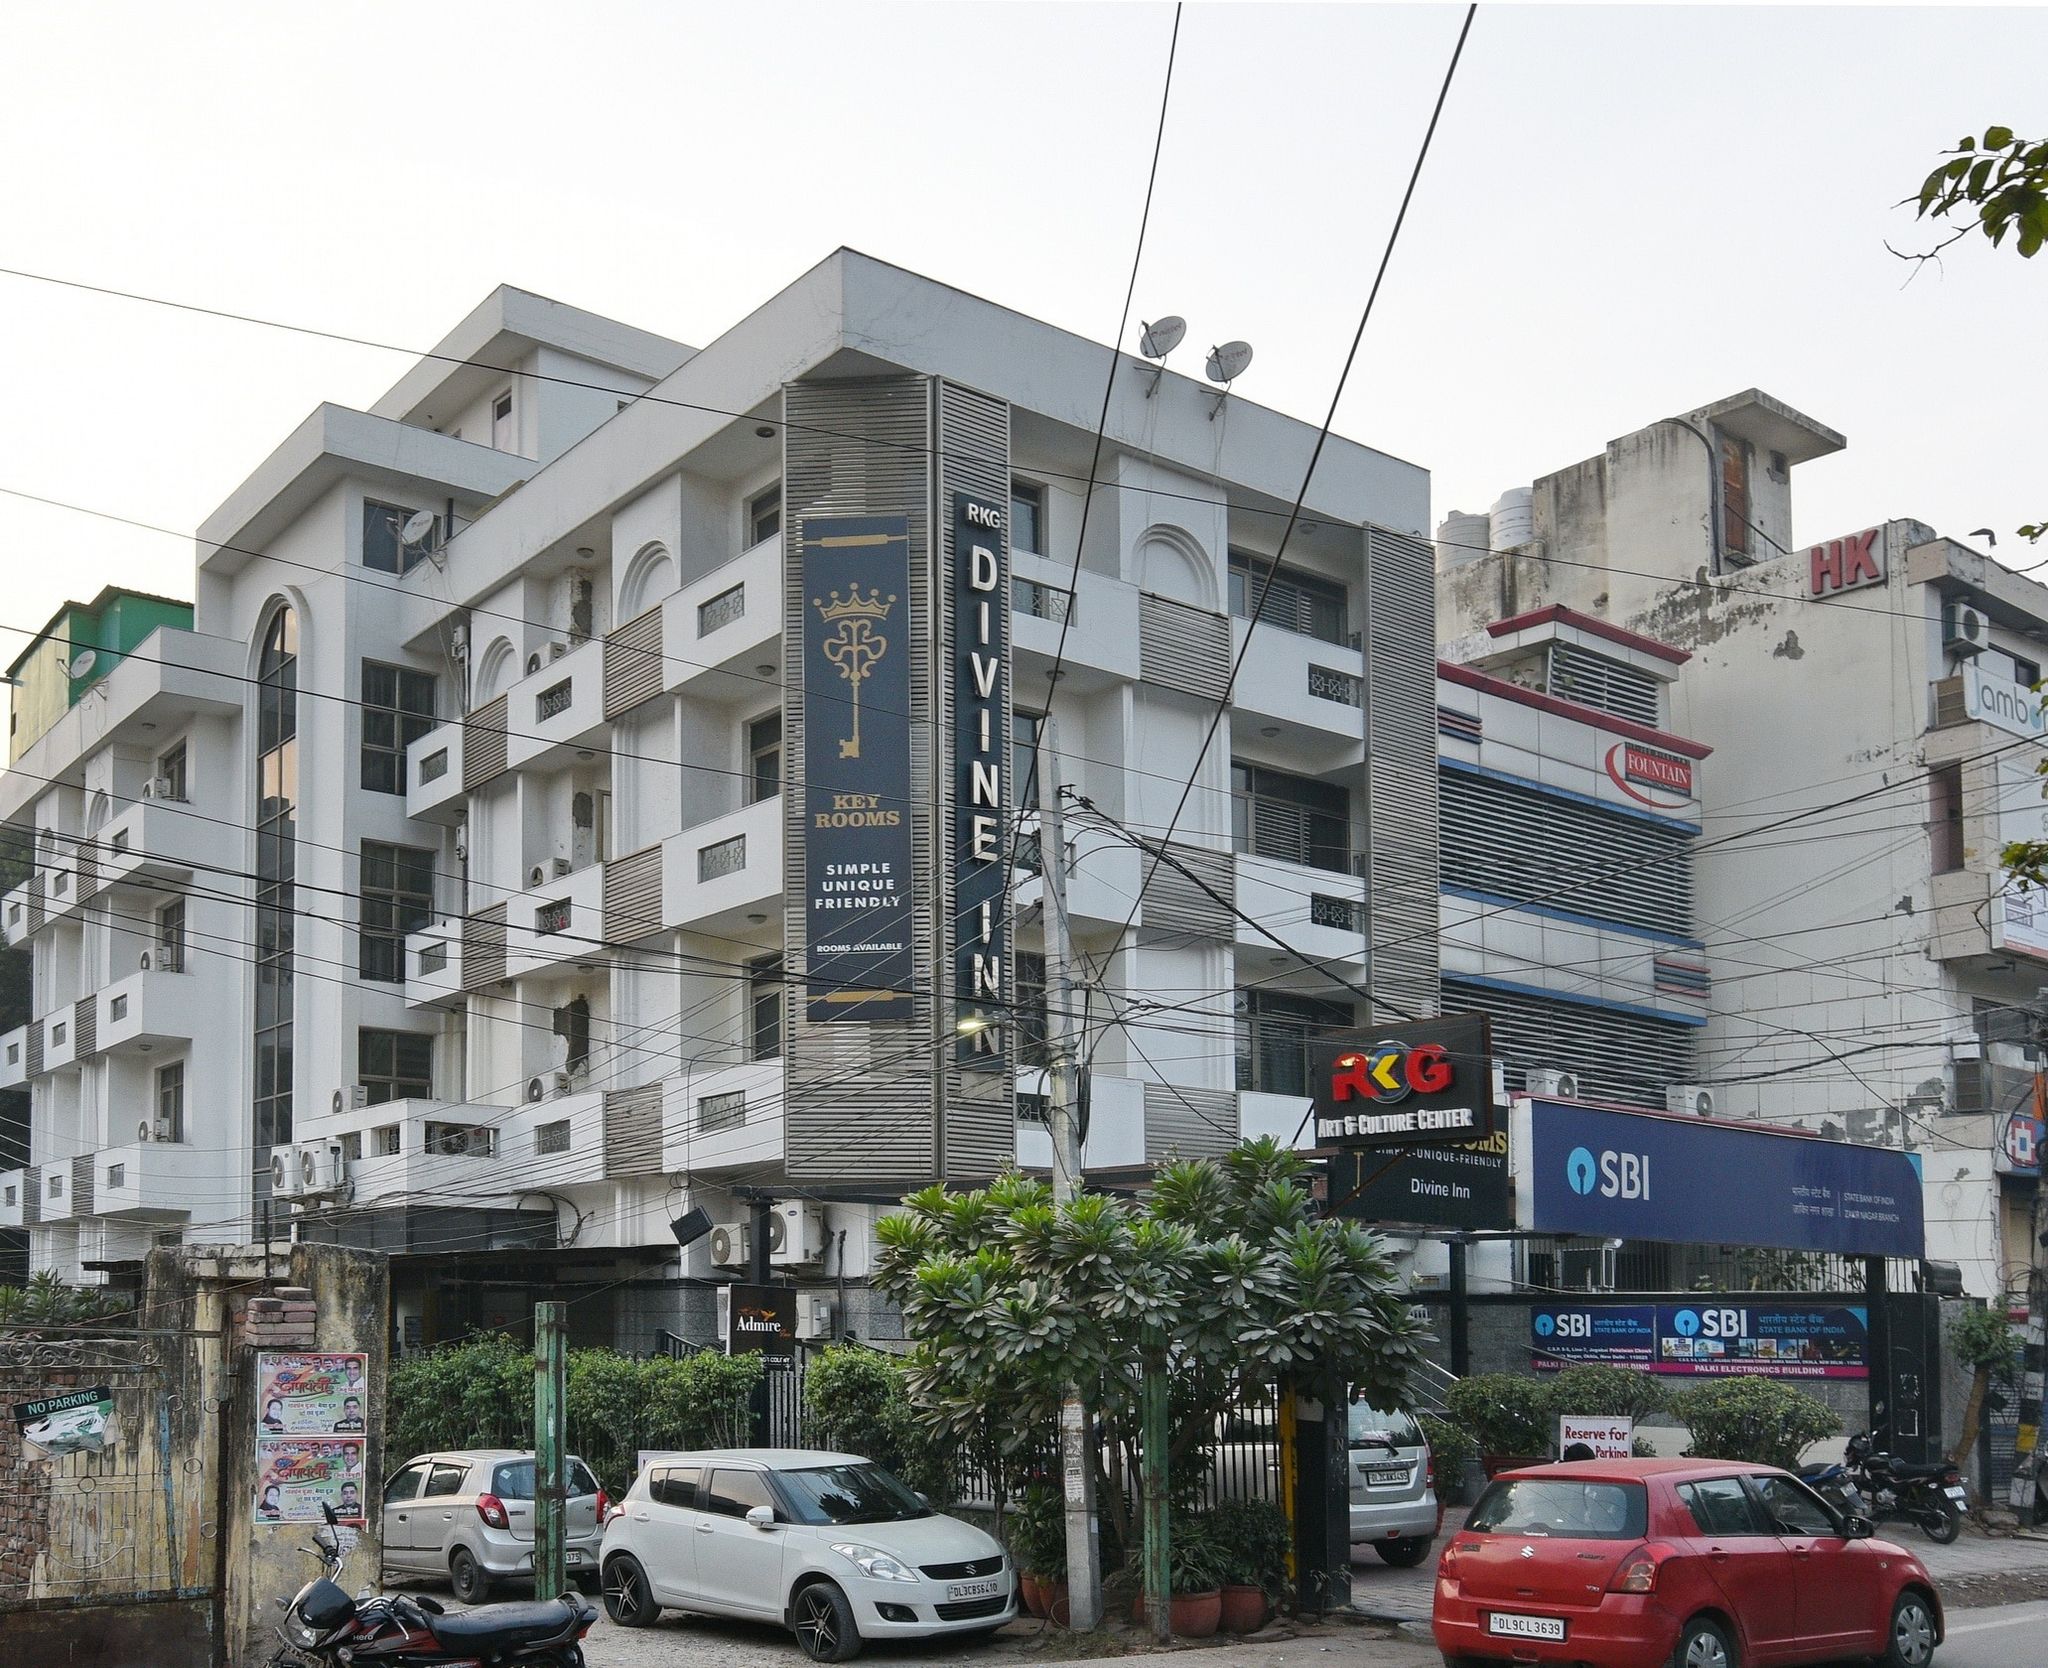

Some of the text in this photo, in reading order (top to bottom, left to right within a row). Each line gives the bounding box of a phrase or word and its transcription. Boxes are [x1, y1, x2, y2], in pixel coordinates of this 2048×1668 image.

[967, 502, 1001, 529] RKG
[1811, 528, 1880, 595] HK
[971, 544, 999, 862] DIVINE
[1628, 753, 1688, 784] FOUNTAIN
[833, 794, 880, 810] KEY
[815, 811, 900, 828] ROOMS
[826, 863, 890, 876] SIMPLE
[823, 879, 895, 892] UNIQUE
[815, 896, 900, 909] FRIENDLY
[817, 943, 903, 953] ROOMS AVAILABLE
[1332, 1043, 1453, 1101] RKG
[1344, 1115, 1357, 1136] &
[1600, 1150, 1650, 1200] SBI
[1411, 1178, 1470, 1199] Divine Inn
[1844, 1192, 1895, 1205] STATE BANK OF INDIA
[1860, 1211, 1877, 1221] NAGAR
[1878, 1212, 1900, 1223] BRANCH
[736, 1315, 781, 1332] Admire
[1556, 1314, 1591, 1337] SBI
[1702, 1309, 1748, 1338] SBI
[1758, 1314, 1787, 1324] भारतीय
[1790, 1313, 1807, 1324] स्टेट
[1759, 1326, 1783, 1334] STATE
[1785, 1326, 1809, 1334] BANK
[1695, 1364, 1825, 1375] PALKI ELECTRONICS BUILDING
[28, 1390, 98, 1415] NO PARKING
[1565, 1425, 1628, 1440] Reserve for
[1499, 1617, 1560, 1635] DL9CL3639
